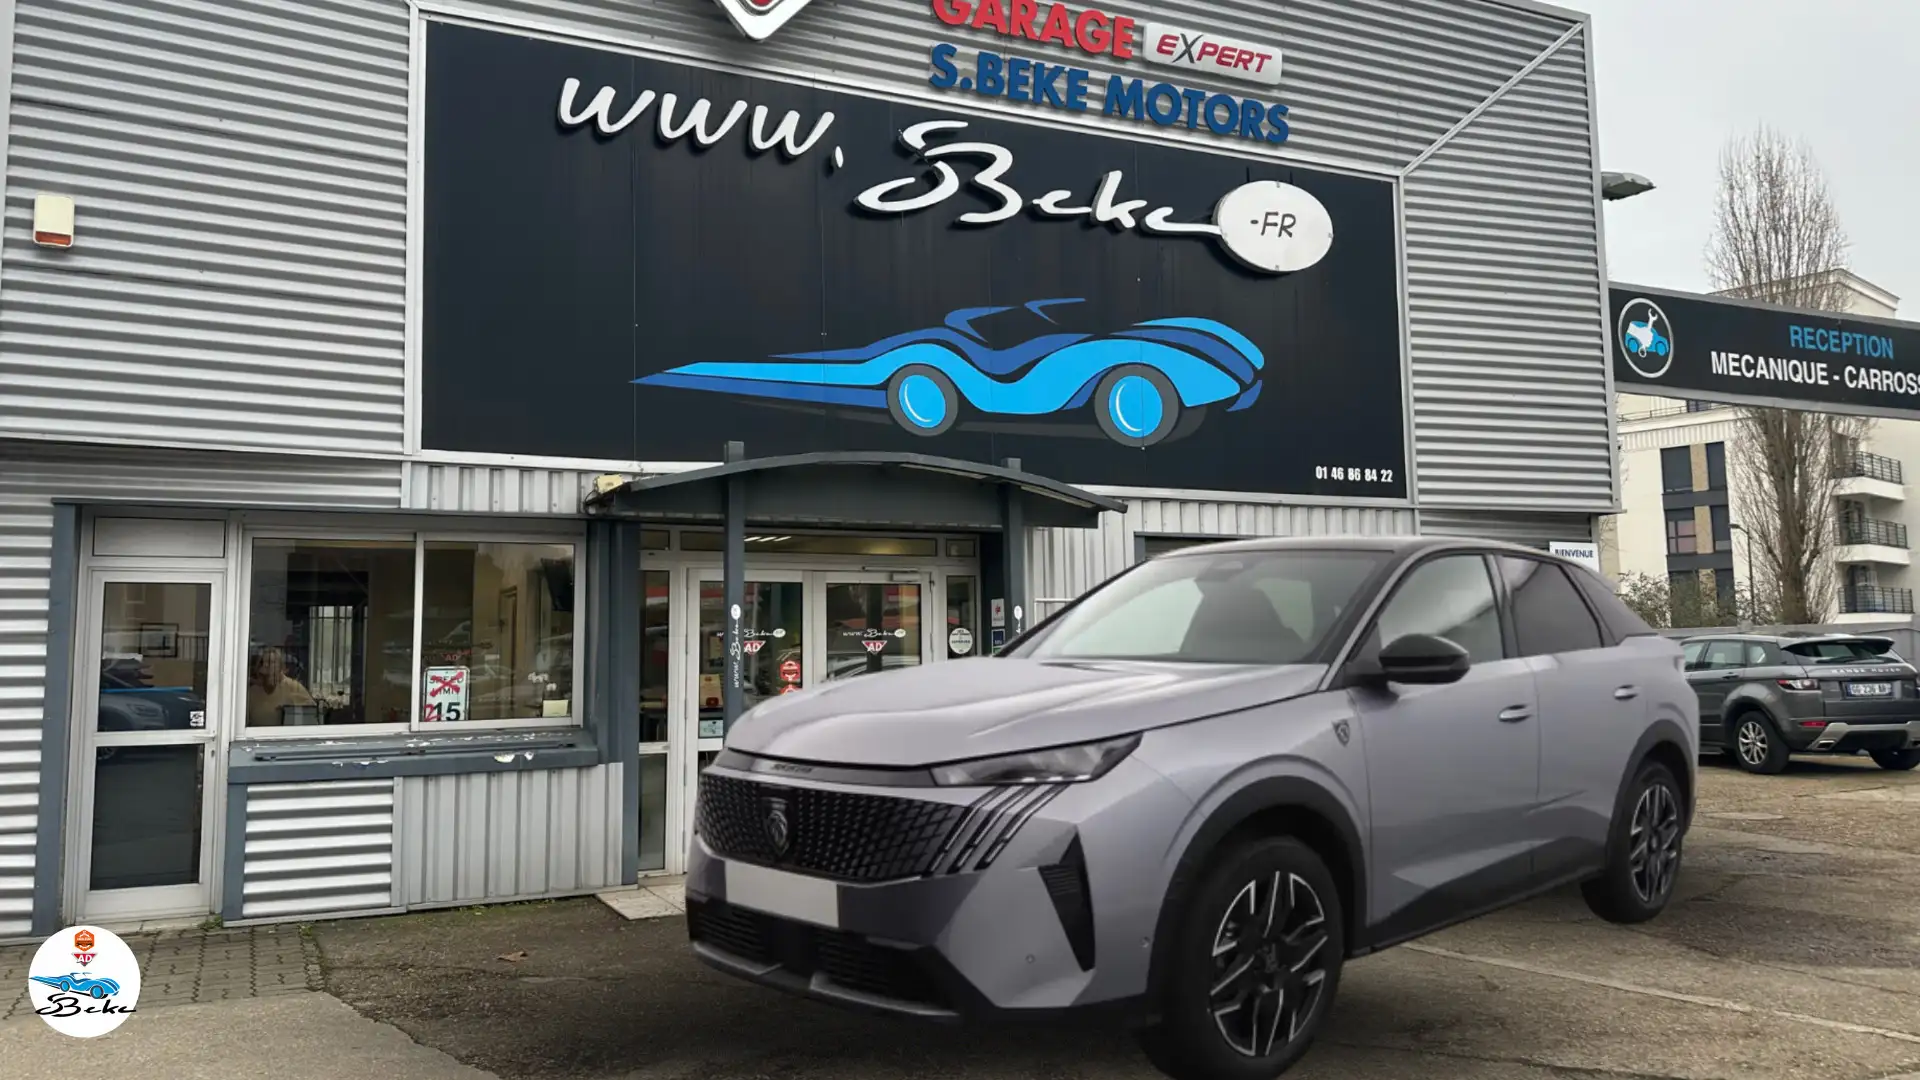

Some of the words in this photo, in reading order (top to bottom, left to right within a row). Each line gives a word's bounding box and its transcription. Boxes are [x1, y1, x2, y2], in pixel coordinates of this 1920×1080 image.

[932, 0, 1134, 59] GARAGE
[929, 43, 1090, 112] S.BEKE
[1103, 75, 1290, 143] MOTORS
[1789, 325, 1895, 360] RECEPTION
[1711, 351, 1829, 385] MECANIQUE
[1844, 365, 1920, 395] CARROS
[1315, 465, 1328, 480] 01
[1331, 467, 1345, 481] 46
[1347, 468, 1361, 481] 86
[1364, 468, 1378, 482] 84
[1380, 469, 1393, 482] 22
[867, 642, 883, 652] AD
